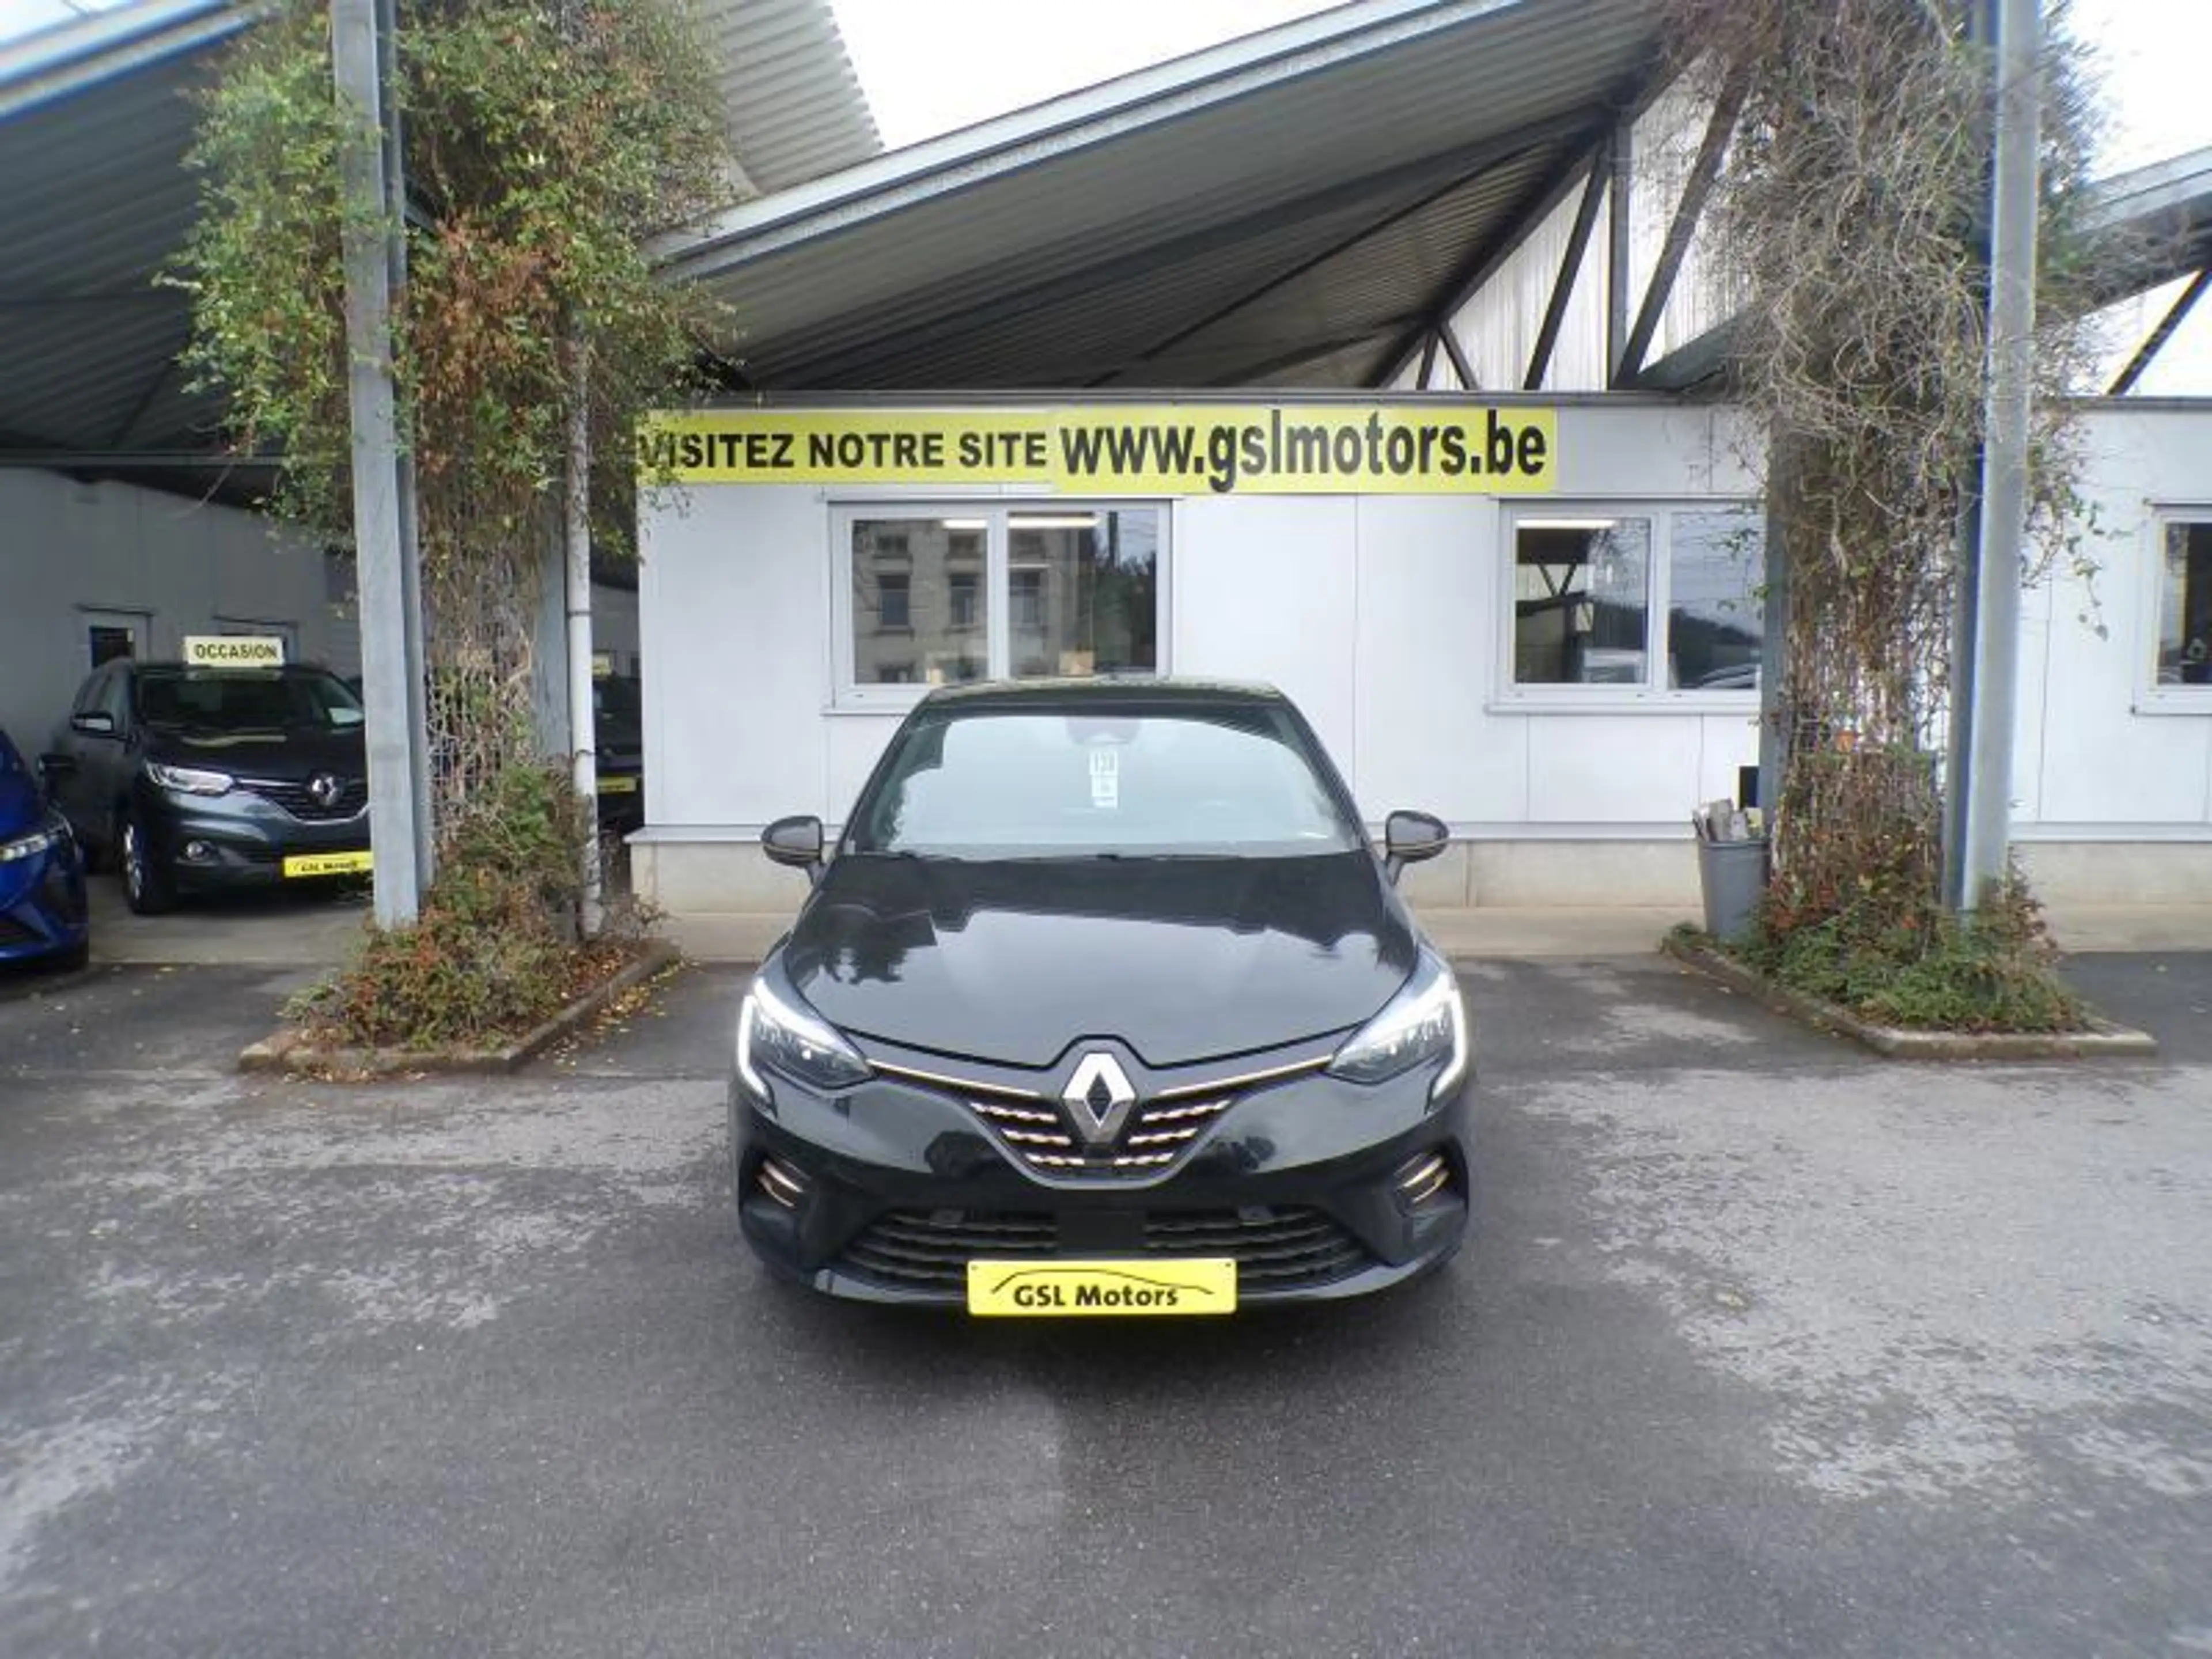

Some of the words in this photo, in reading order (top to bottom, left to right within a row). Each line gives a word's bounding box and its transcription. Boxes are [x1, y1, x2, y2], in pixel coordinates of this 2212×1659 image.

[809, 434, 944, 468] NOTRE
[959, 433, 1047, 468] SITE
[1059, 410, 1547, 493] www.gslmotors.be
[194, 643, 278, 659] OCCASION
[1014, 1285, 1065, 1306] GSL
[1075, 1285, 1178, 1306] Motors
